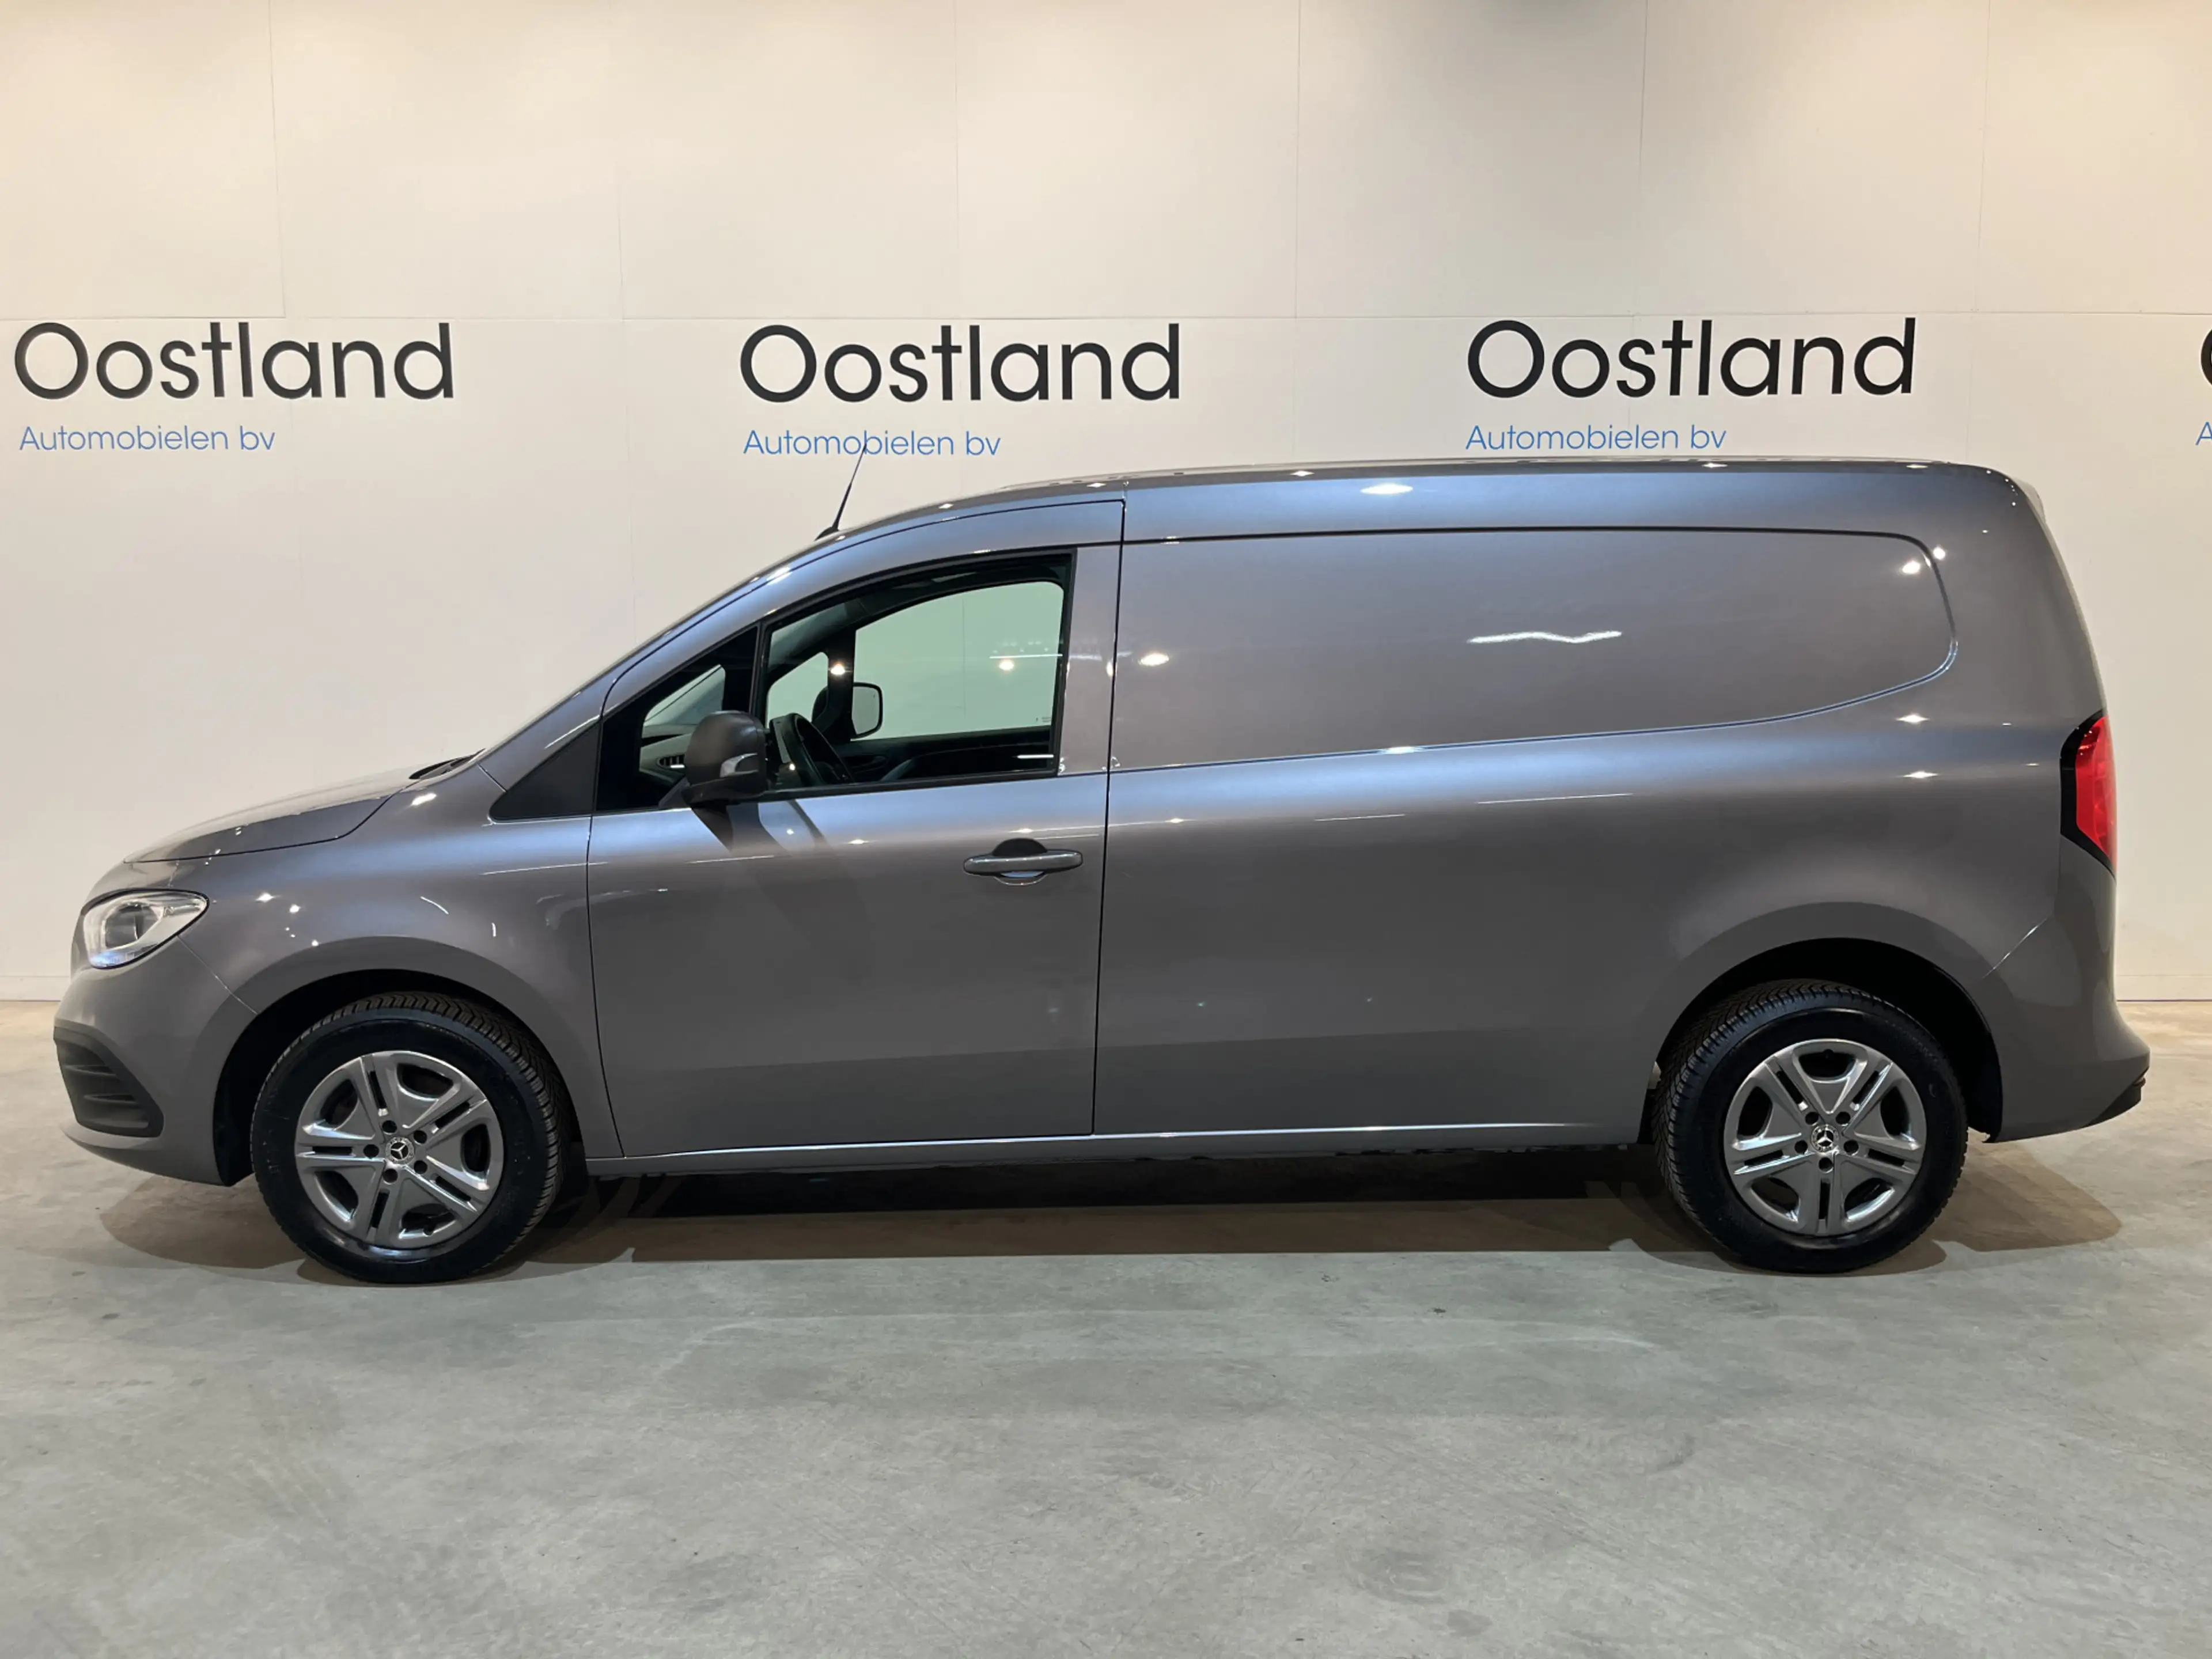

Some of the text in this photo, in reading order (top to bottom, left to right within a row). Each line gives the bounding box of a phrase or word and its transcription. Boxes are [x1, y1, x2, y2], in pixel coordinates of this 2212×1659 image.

[14, 322, 453, 400] Oostland
[740, 323, 1179, 403] Oostland
[1467, 317, 1916, 399] Oostland
[20, 425, 275, 451] Automobielen bv
[743, 429, 1001, 456] Automobielen bv
[1465, 424, 1727, 450] Automobielen bv
